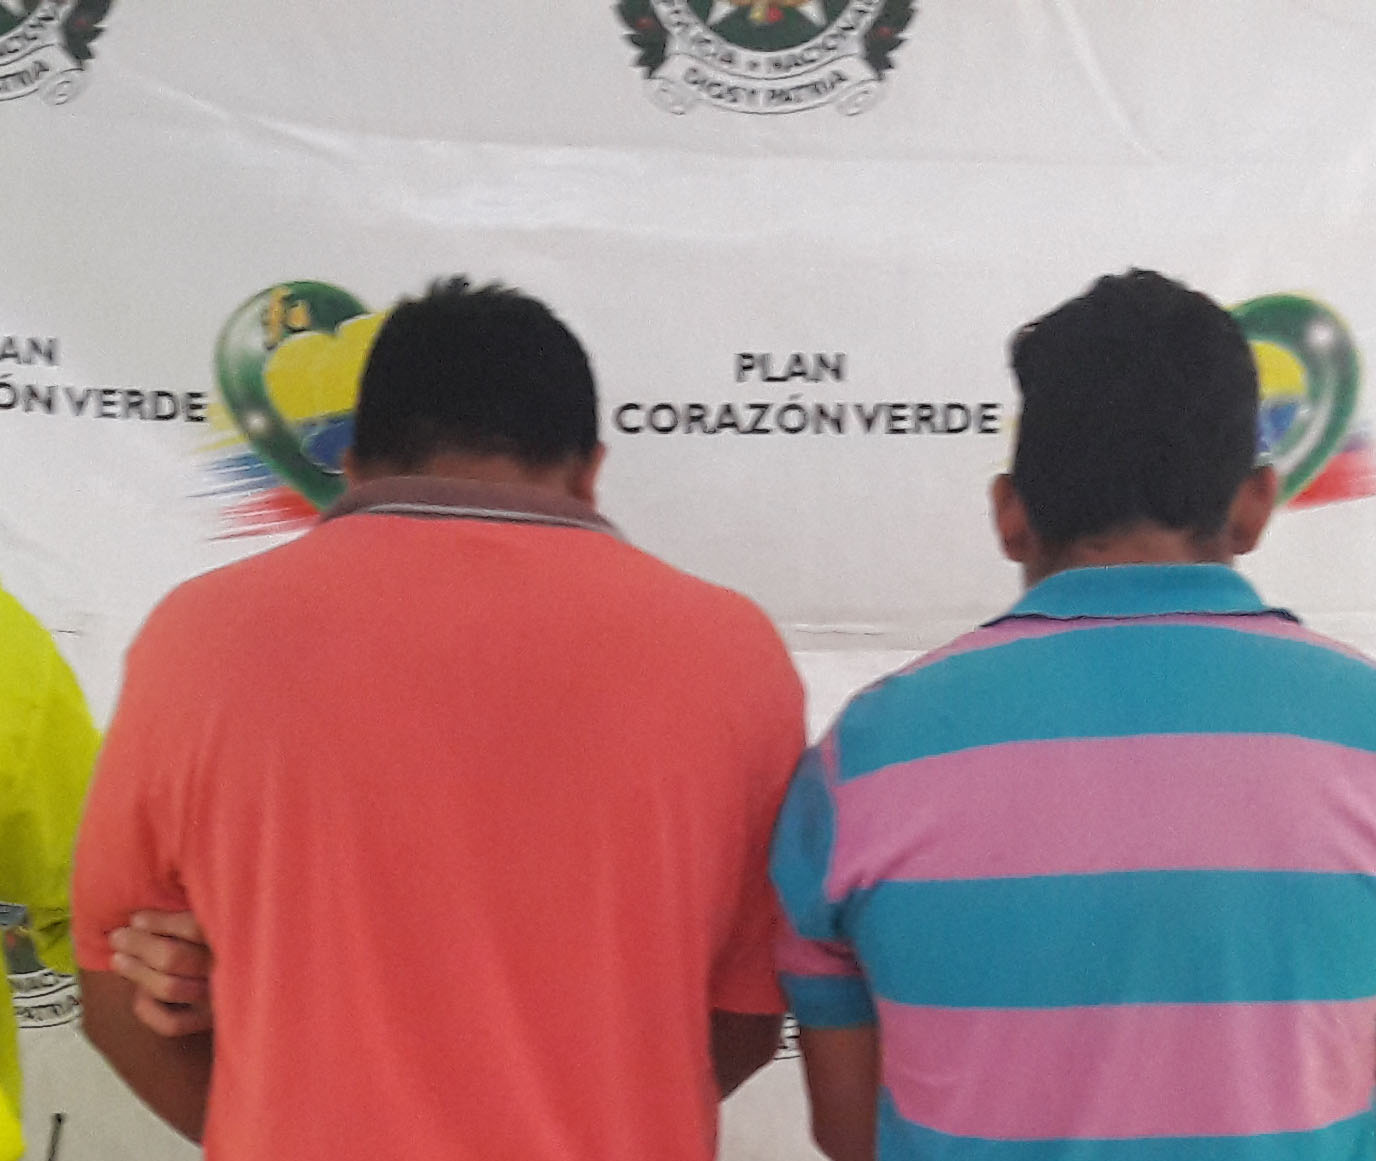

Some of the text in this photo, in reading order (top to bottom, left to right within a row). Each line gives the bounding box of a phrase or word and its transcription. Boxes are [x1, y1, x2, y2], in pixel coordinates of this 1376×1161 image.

[734, 352, 846, 383] PLAN
[63, 385, 208, 424] VERDE
[613, 393, 1003, 435] CORAZÓN VERDE
